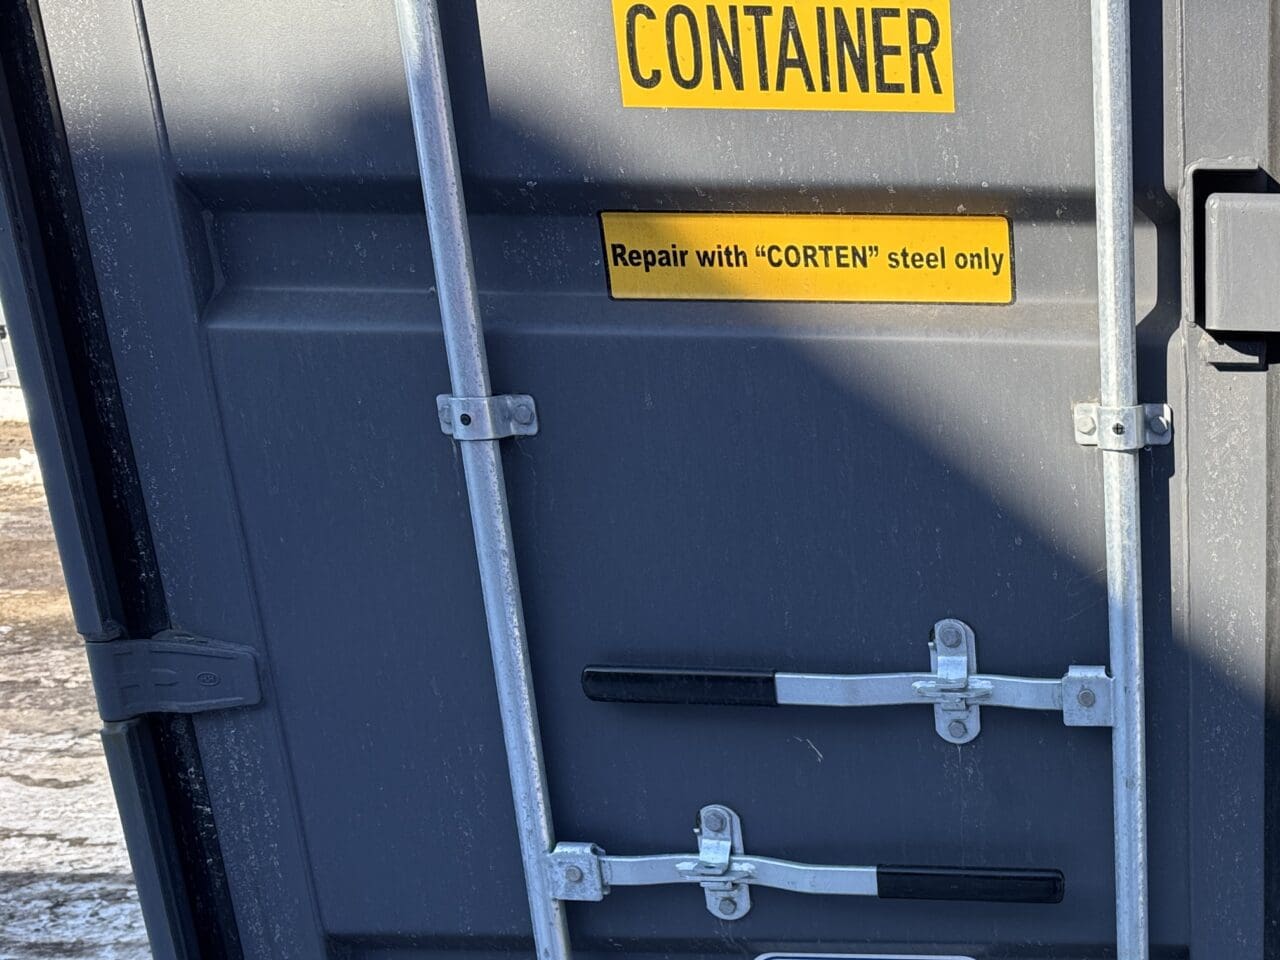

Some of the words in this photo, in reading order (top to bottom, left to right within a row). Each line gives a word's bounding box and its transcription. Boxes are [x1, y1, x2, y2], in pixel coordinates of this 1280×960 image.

[625, 3, 943, 95] CONTAINER
[611, 243, 689, 273] Repair
[696, 244, 748, 269] with
[755, 243, 880, 270] “CORTEN”
[888, 246, 947, 270] steel
[954, 246, 1005, 277] only
